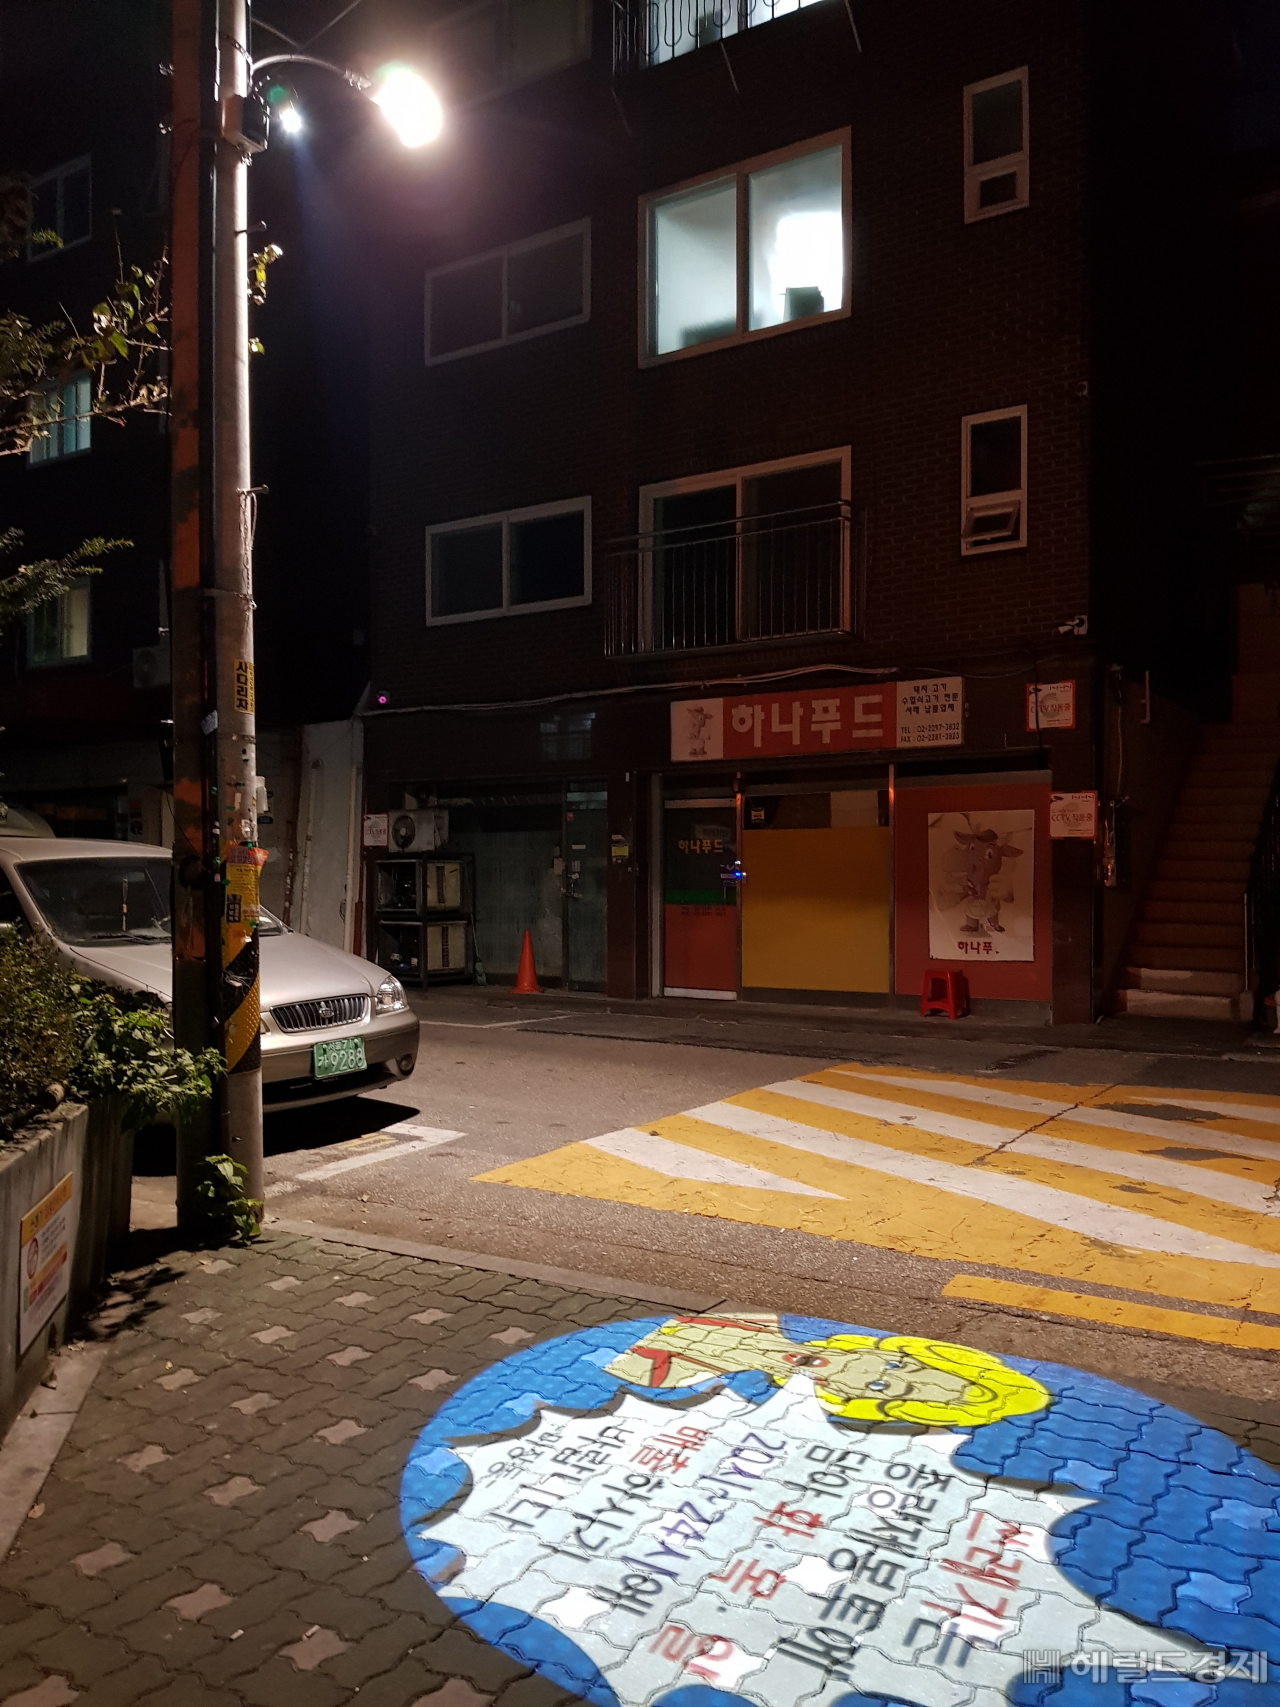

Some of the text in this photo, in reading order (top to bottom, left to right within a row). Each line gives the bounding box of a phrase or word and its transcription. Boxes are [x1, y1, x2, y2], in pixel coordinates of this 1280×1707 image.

[932, 683, 947, 692] 고기
[944, 692, 959, 702] 전문
[731, 694, 884, 748] 하나푸드
[678, 838, 724, 854] 하나푸드
[489, 1425, 635, 1529] 바랍니다
[538, 1425, 713, 1564] 배출하시기
[785, 1445, 868, 1499] 담아
[777, 1461, 952, 1680] 종량제봉투에
[901, 1511, 1035, 1669] 쓰레기는
